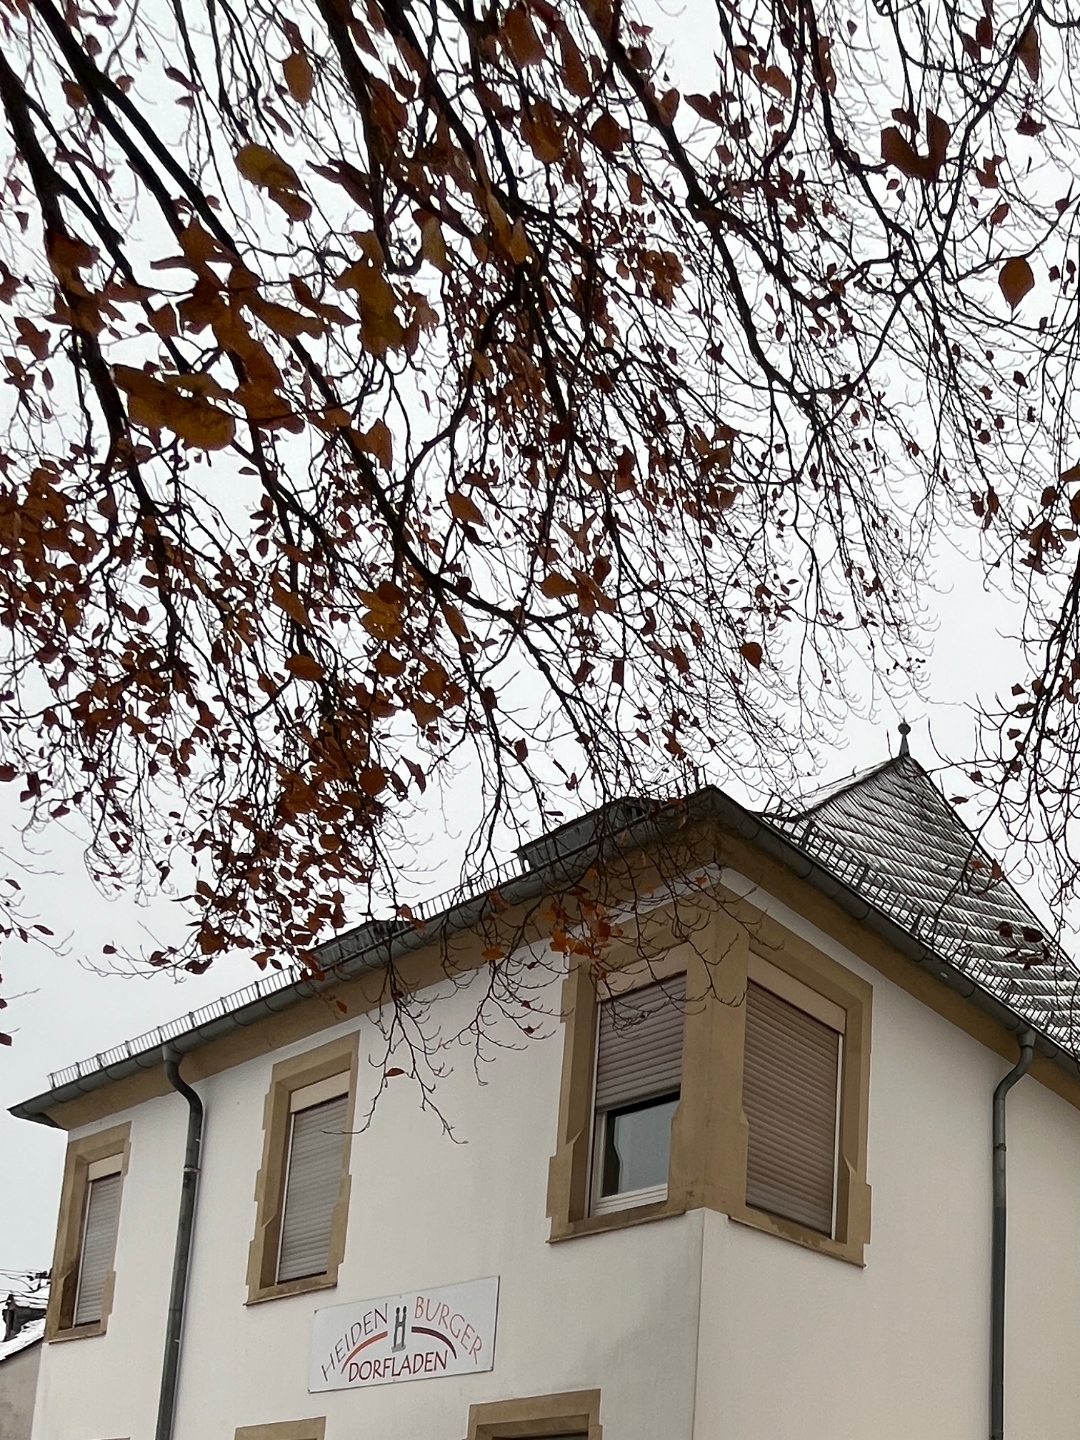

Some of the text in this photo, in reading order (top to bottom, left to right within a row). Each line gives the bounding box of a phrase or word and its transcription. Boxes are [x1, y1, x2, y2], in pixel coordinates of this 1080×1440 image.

[321, 1302, 389, 1382] HEIDEN
[414, 1295, 483, 1366] BURGER
[348, 1349, 449, 1383] DORFLADEN
